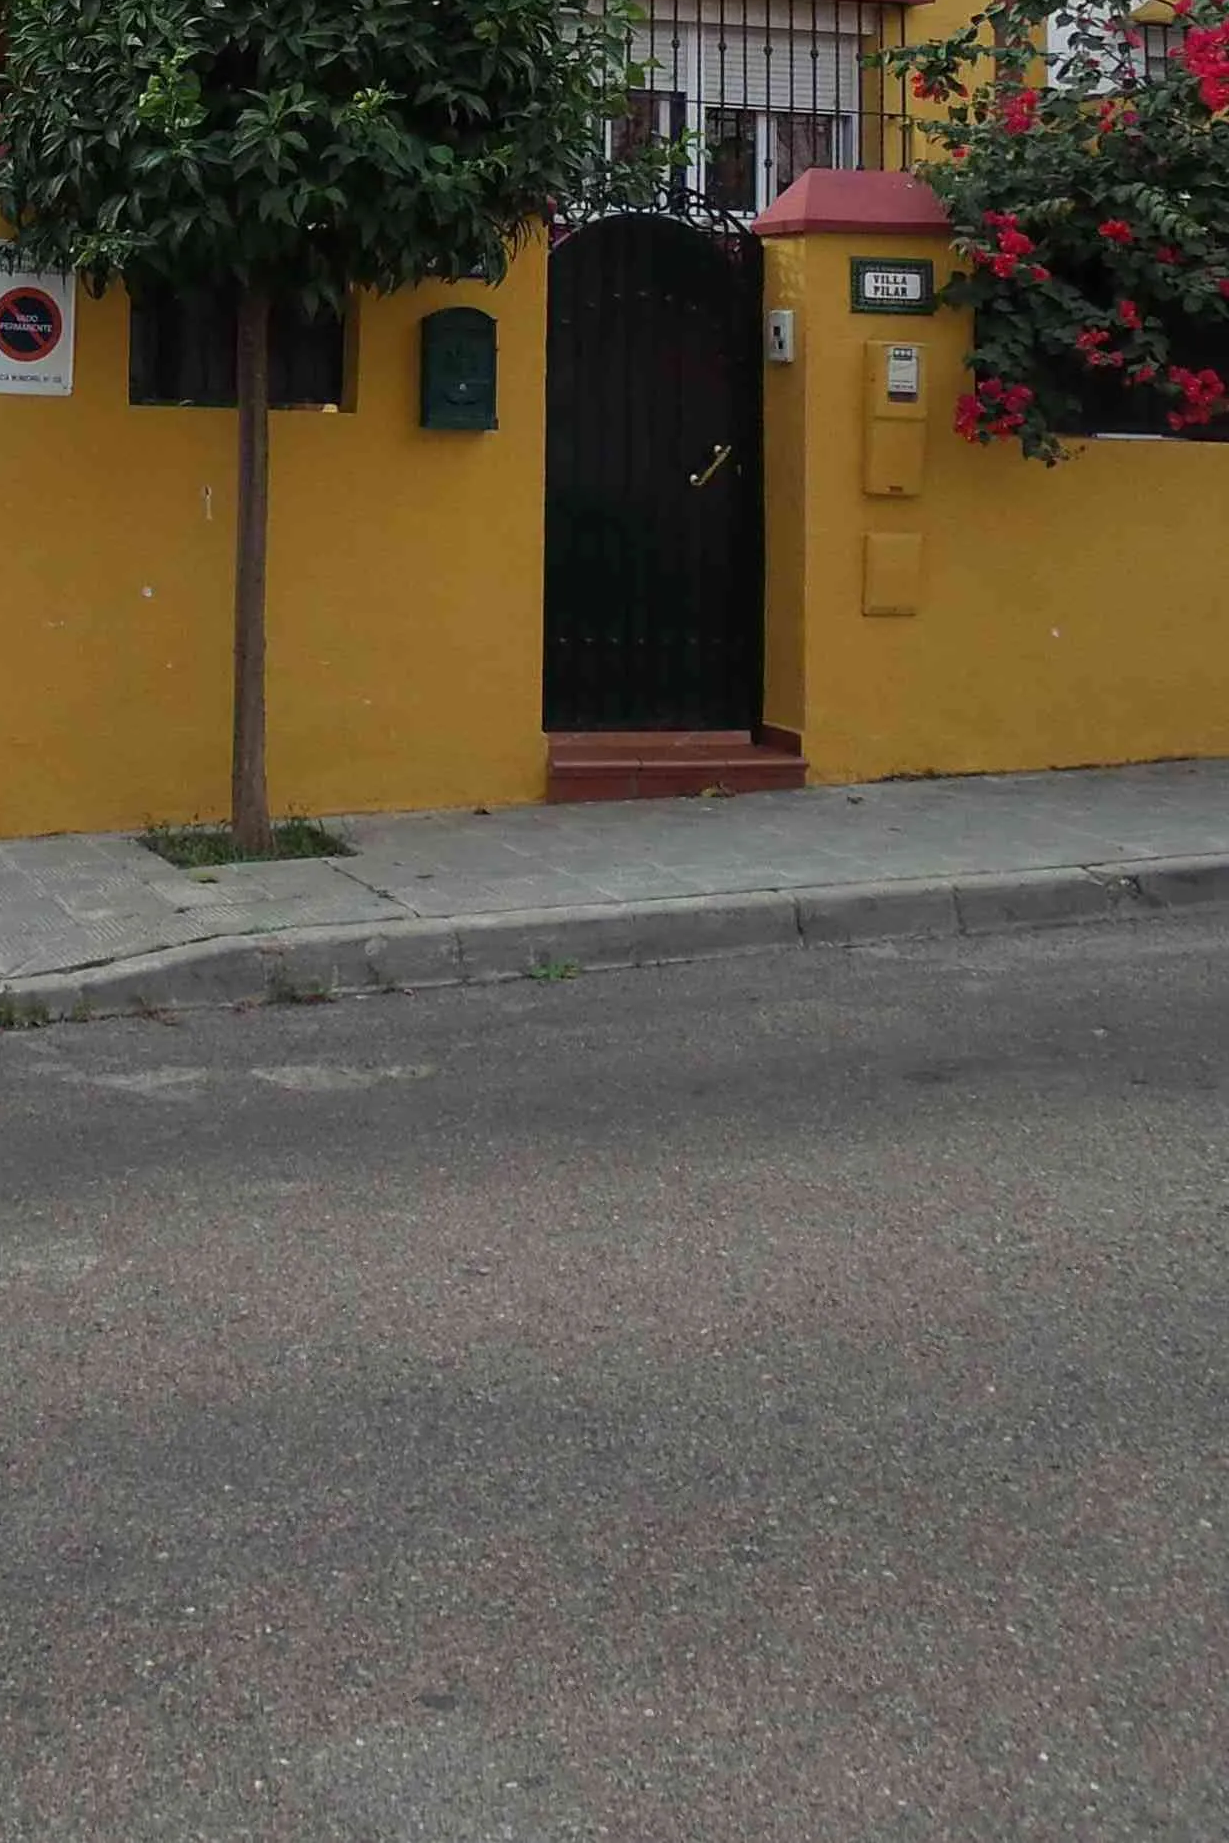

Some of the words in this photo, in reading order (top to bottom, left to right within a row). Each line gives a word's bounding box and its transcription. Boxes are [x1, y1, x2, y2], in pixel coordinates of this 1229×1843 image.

[873, 274, 907, 285] VILLA
[873, 286, 907, 297] PILAR
[16, 315, 37, 323] VADO
[0, 322, 52, 332] PERMANENTE
